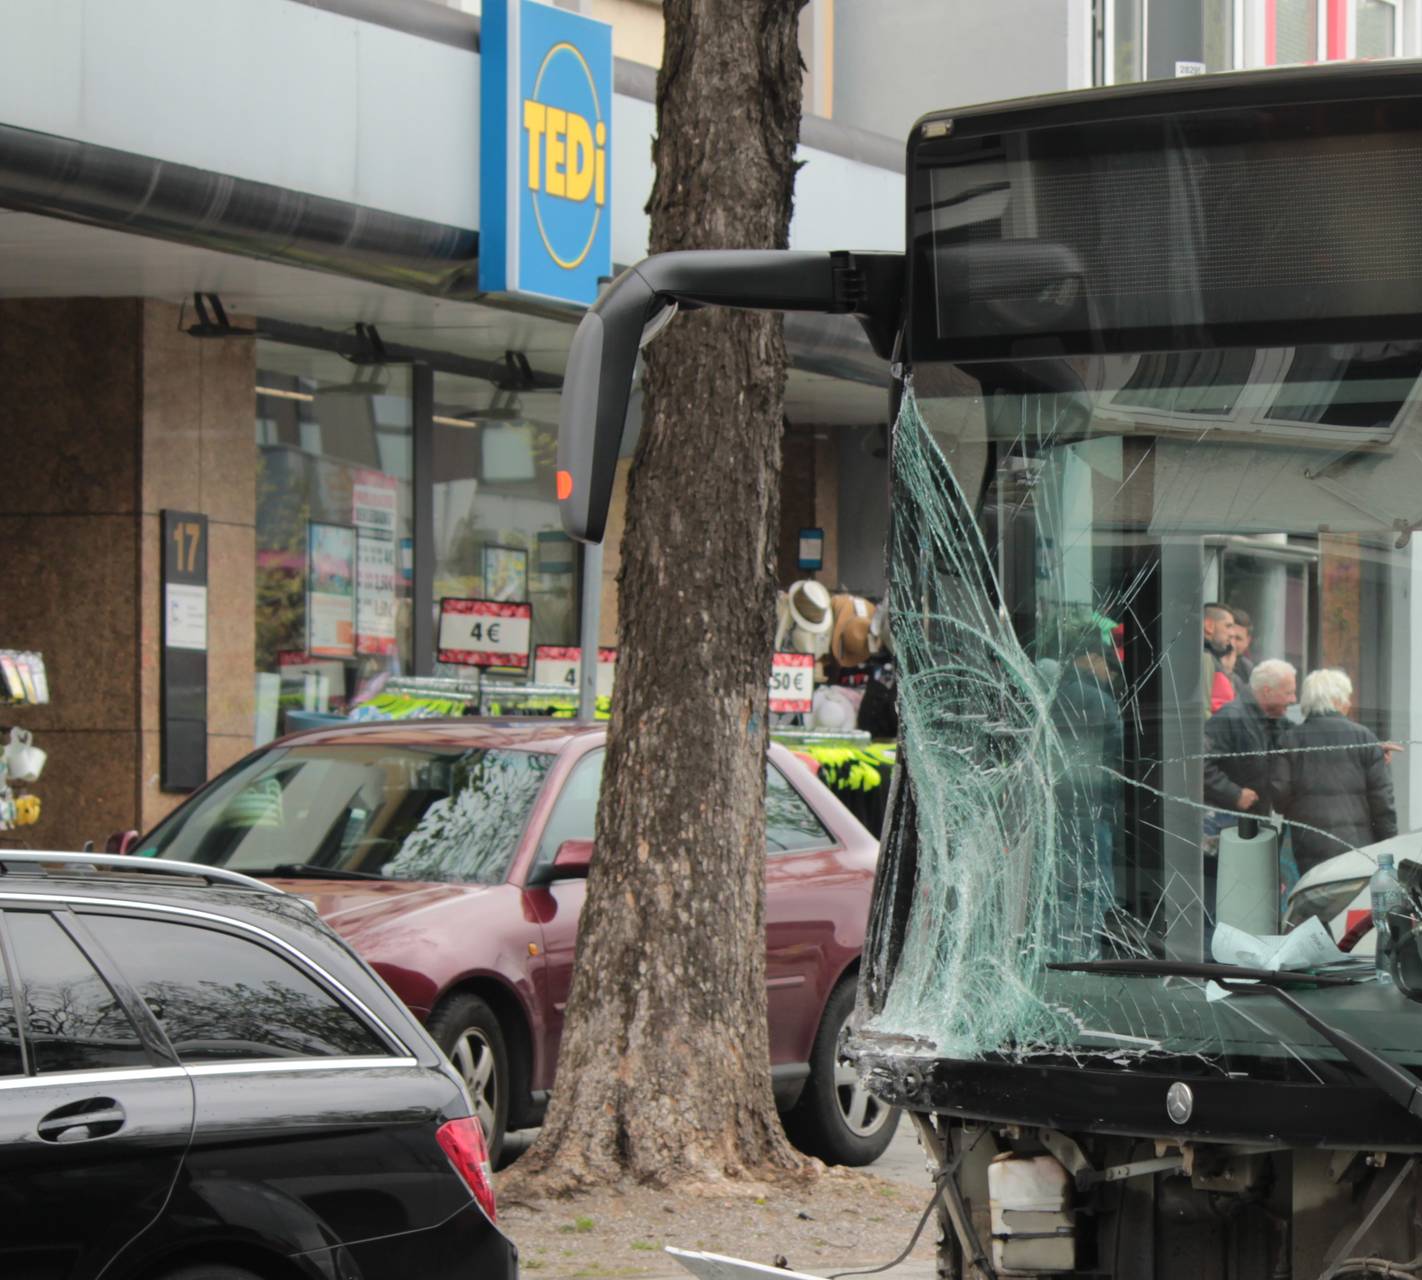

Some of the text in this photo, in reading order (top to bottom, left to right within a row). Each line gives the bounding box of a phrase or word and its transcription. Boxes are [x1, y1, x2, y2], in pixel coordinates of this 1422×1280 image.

[522, 98, 607, 207] TEDi
[173, 521, 202, 573] 17
[470, 621, 501, 643] 4 €
